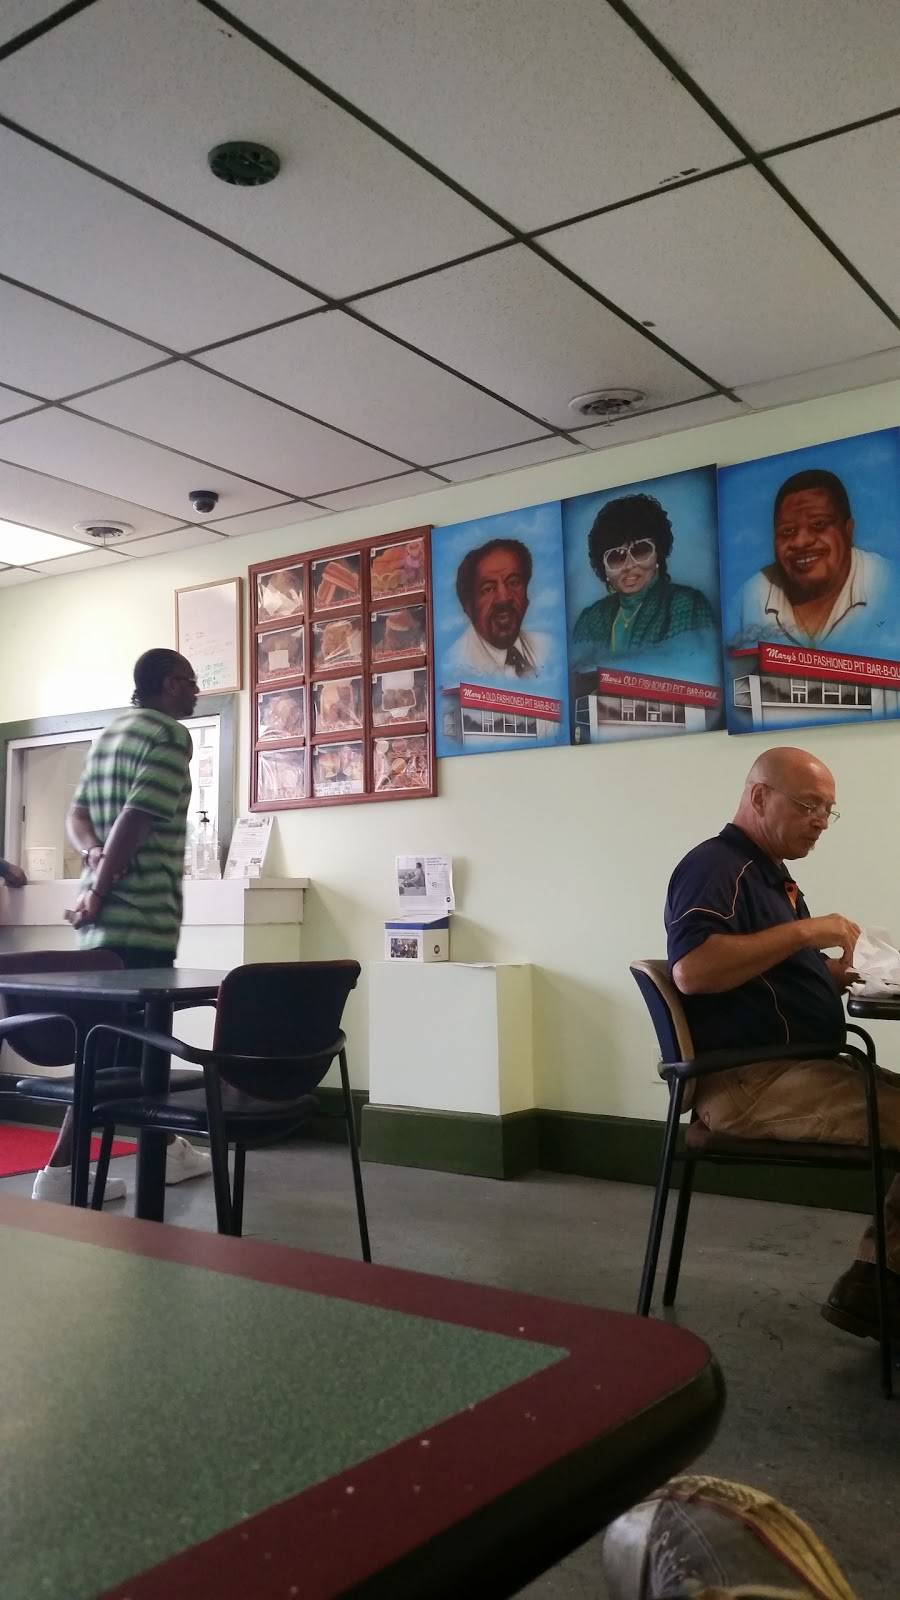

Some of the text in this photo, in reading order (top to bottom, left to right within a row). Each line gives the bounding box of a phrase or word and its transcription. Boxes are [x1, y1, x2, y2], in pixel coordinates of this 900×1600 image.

[766, 647, 900, 678] Mary's OLD FASHIONED PIT BAR-B-QU
[623, 675, 637, 686] OLD
[672, 684, 685, 694] PIT
[463, 688, 486, 699] Mary's
[485, 691, 496, 702] OLD
[496, 693, 524, 707] FASHIONED
[525, 698, 533, 708] PIT
